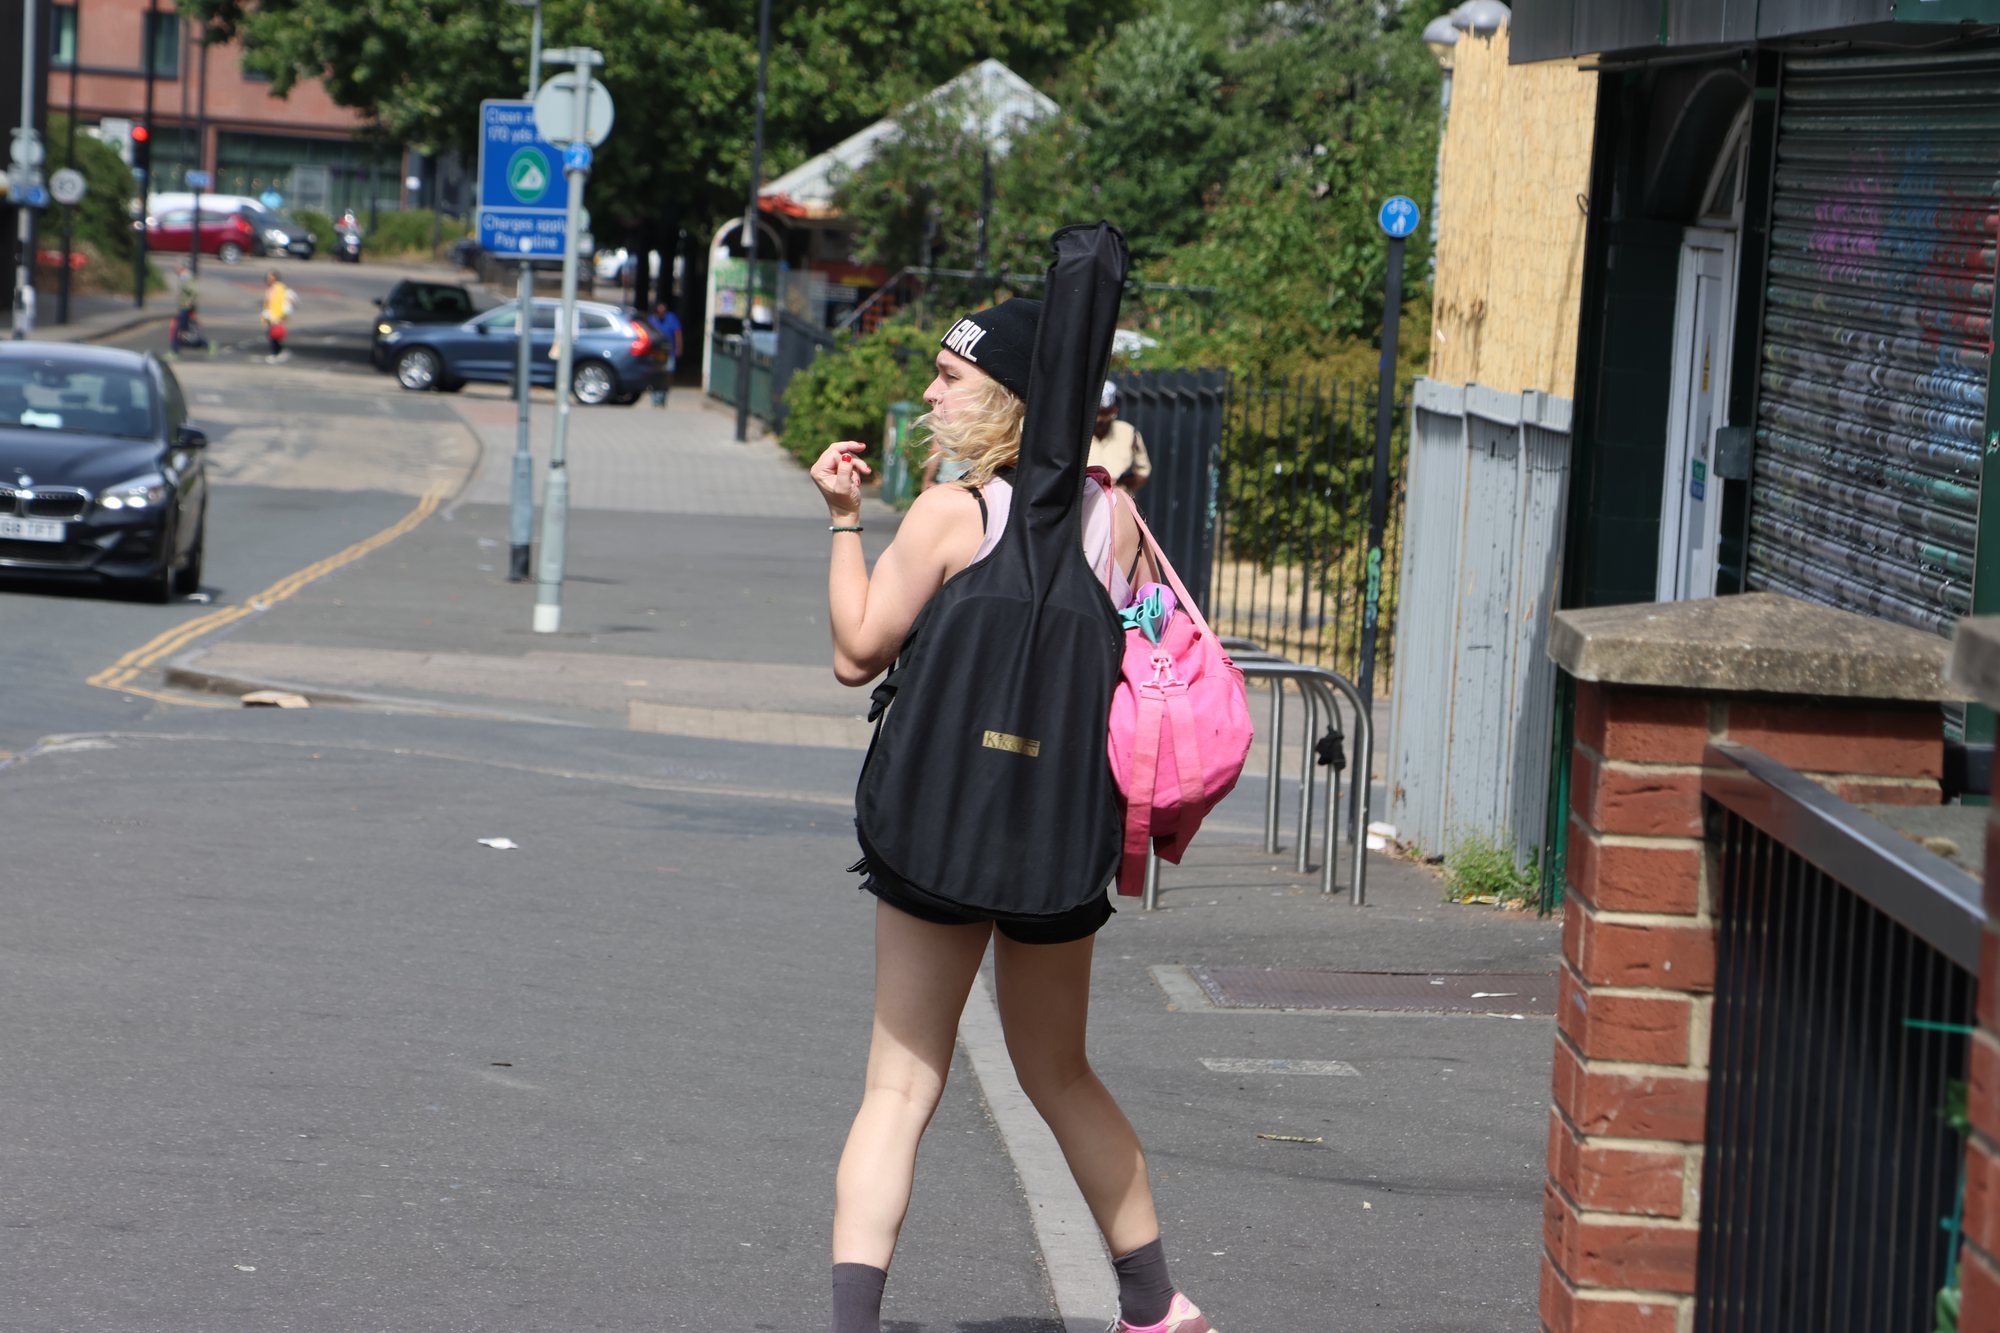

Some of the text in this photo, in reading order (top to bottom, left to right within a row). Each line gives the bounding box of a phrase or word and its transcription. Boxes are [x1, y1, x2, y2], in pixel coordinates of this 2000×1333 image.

[483, 214, 534, 233] Charges
[495, 232, 516, 249] Pay
[946, 319, 987, 362] GIRL
